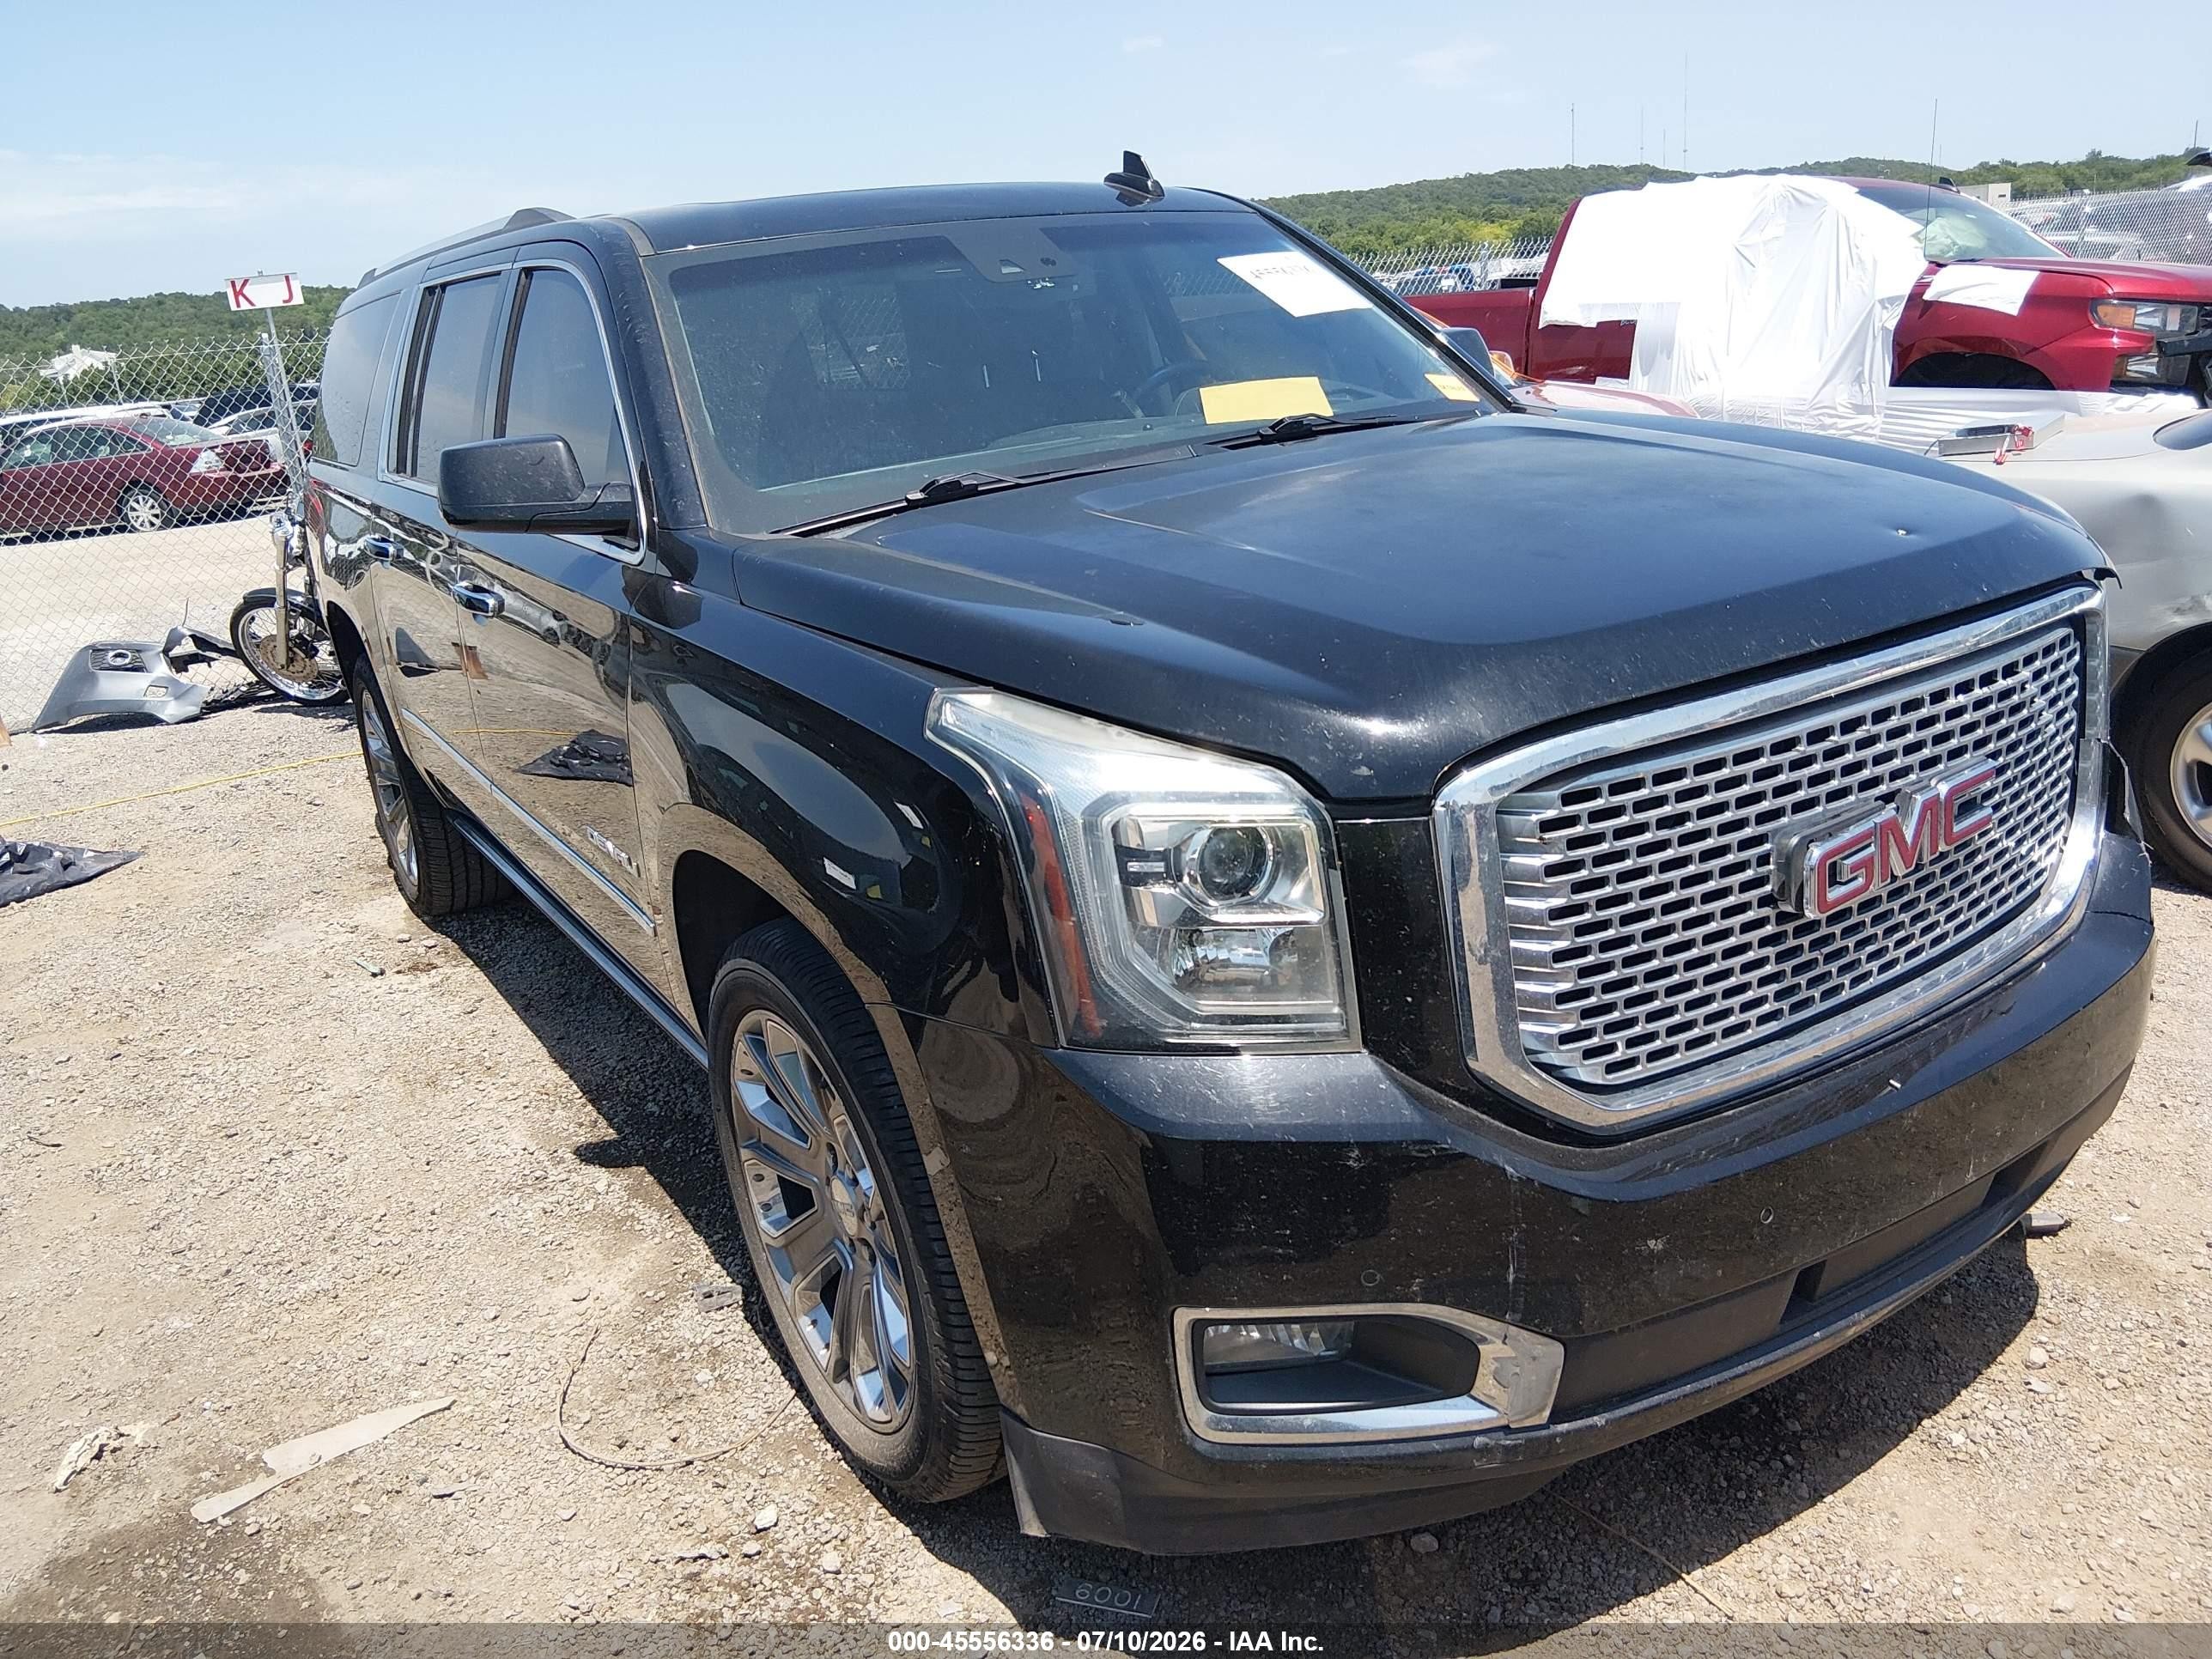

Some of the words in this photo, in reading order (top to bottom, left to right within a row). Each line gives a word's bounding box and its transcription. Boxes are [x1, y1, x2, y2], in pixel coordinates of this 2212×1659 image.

[230, 278, 257, 308] K
[282, 275, 294, 304] J
[1804, 757, 1998, 919] GMC
[1075, 1583, 1142, 1610] 6001
